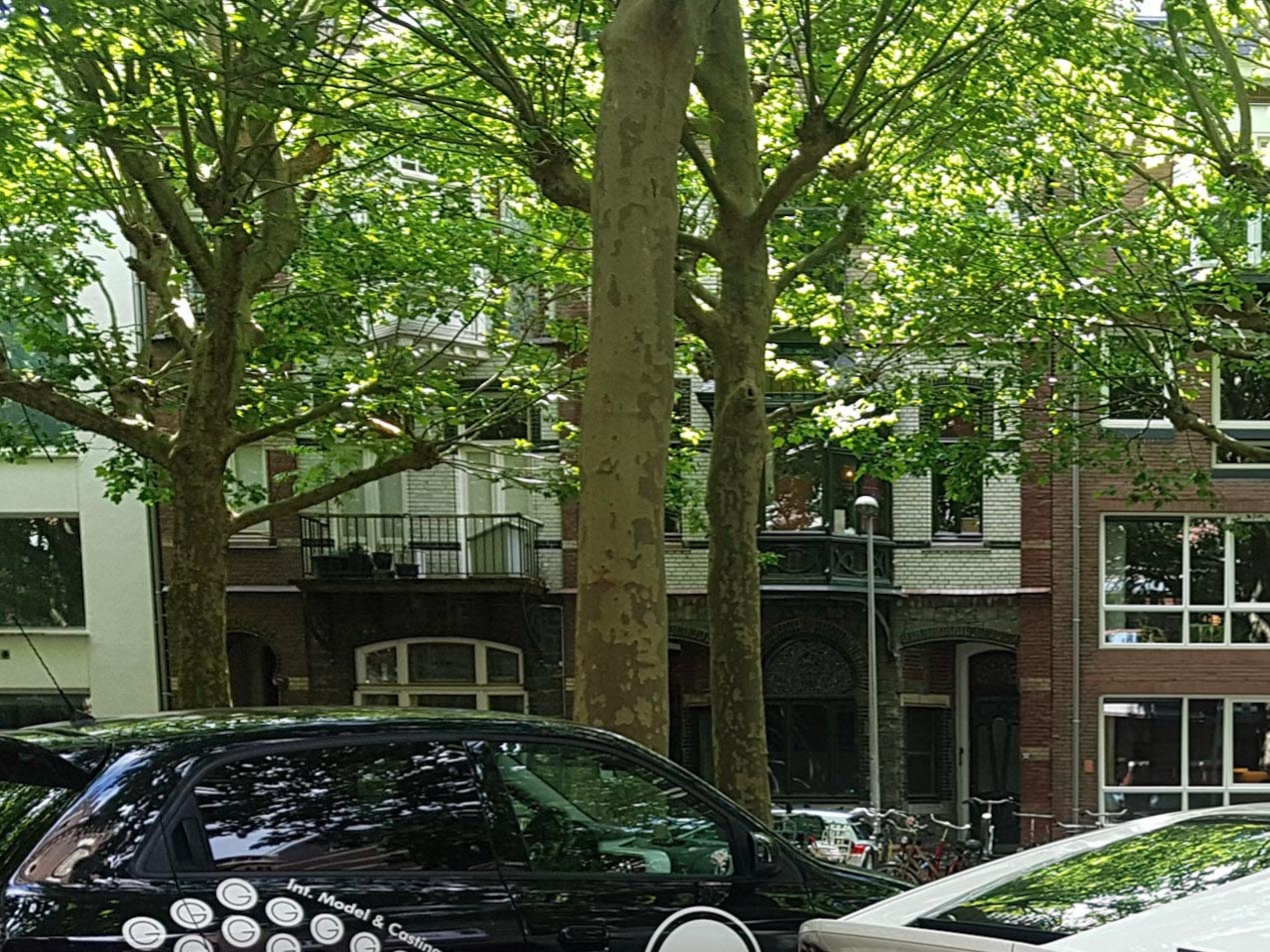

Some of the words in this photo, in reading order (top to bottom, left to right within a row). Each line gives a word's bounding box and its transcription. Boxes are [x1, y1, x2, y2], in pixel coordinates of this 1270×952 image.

[286, 878, 313, 899] Int.
[317, 892, 371, 921] Model
[372, 914, 385, 930] &
